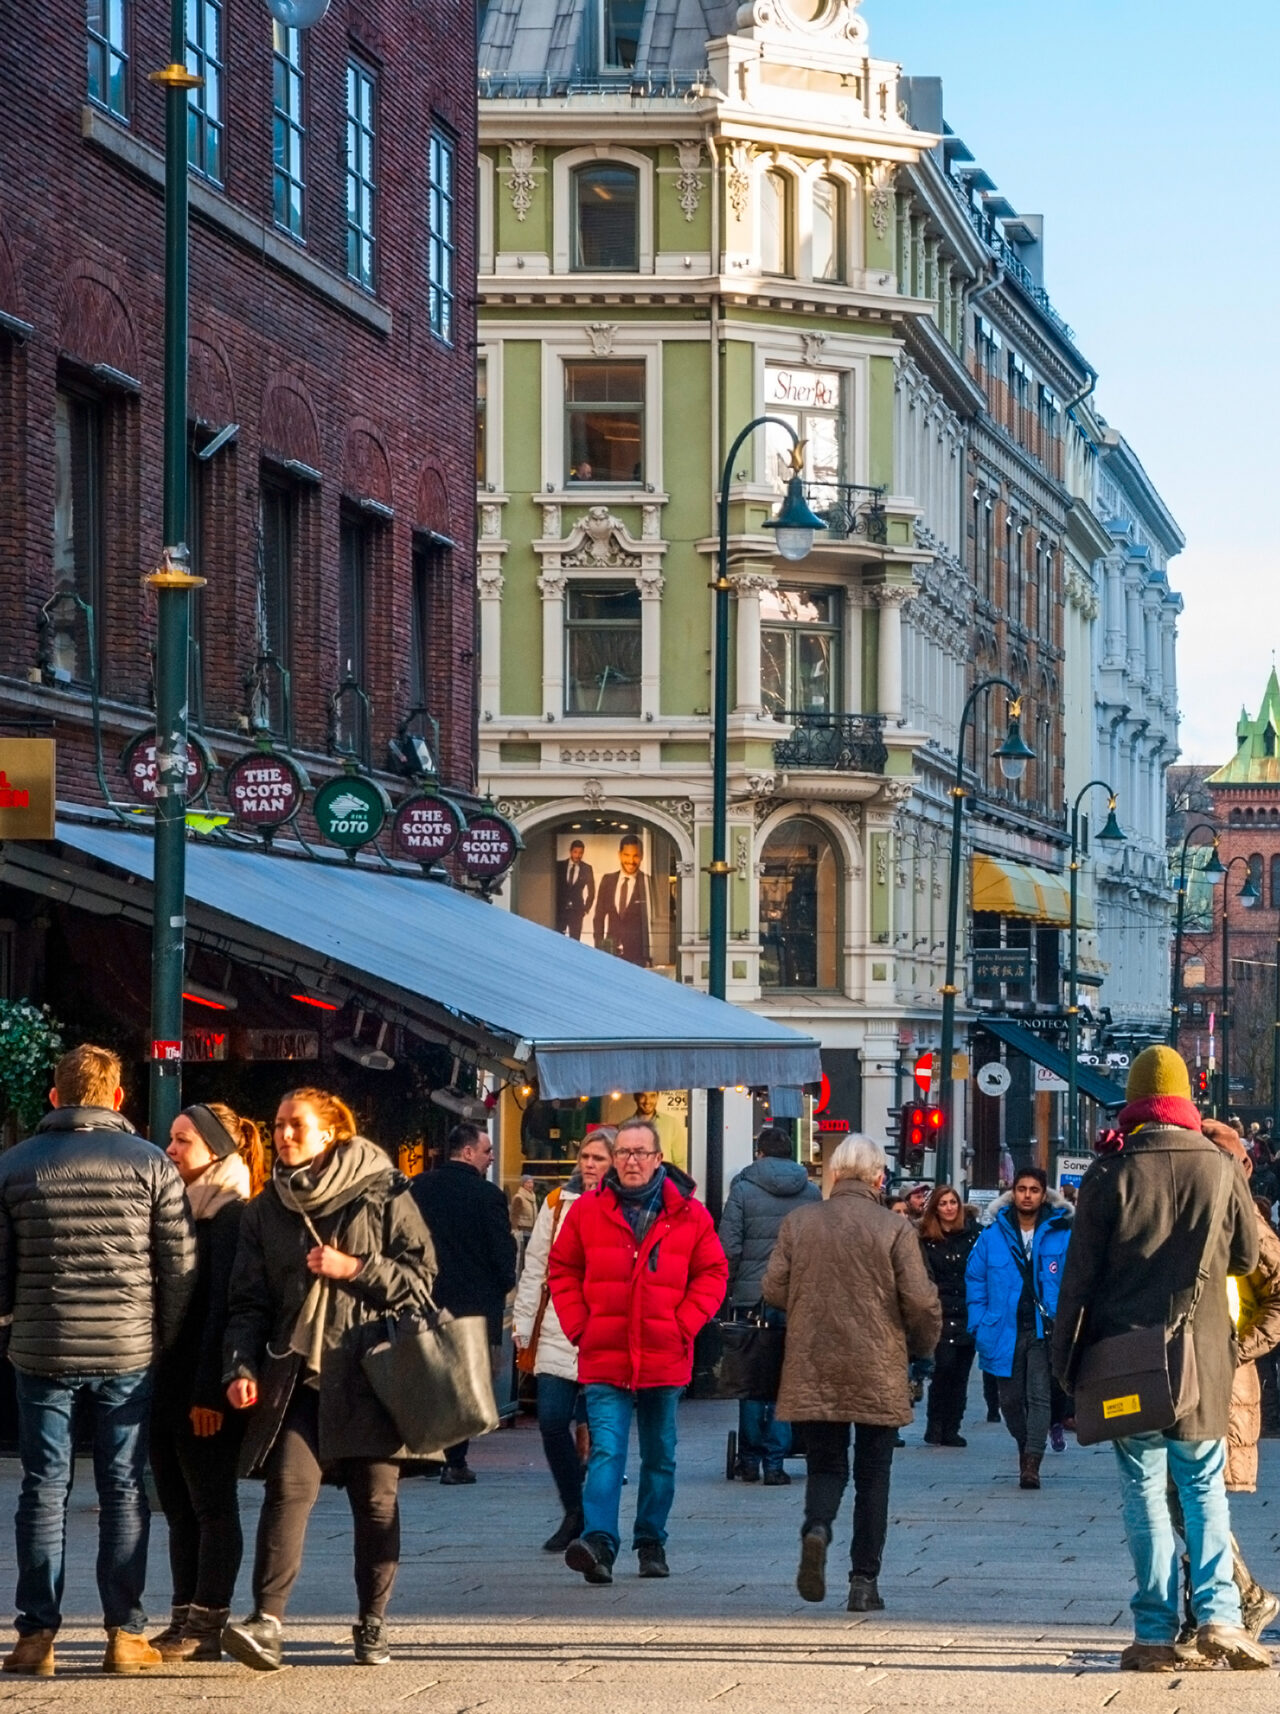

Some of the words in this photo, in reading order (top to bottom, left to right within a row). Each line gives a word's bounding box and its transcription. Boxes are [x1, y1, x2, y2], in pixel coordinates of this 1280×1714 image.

[244, 768, 282, 783] THE
[235, 783, 292, 799] SCOTS
[243, 798, 284, 812] MAN
[411, 810, 443, 822] THE
[330, 820, 369, 834] TOTO
[402, 823, 452, 835] SCOTS
[471, 830, 500, 840] THE
[407, 836, 444, 847] MAN
[462, 842, 509, 853] SCOTS
[467, 853, 501, 864] MAN
[1017, 1019, 1068, 1029] ENOTECA
[1064, 1160, 1088, 1170] Sone
